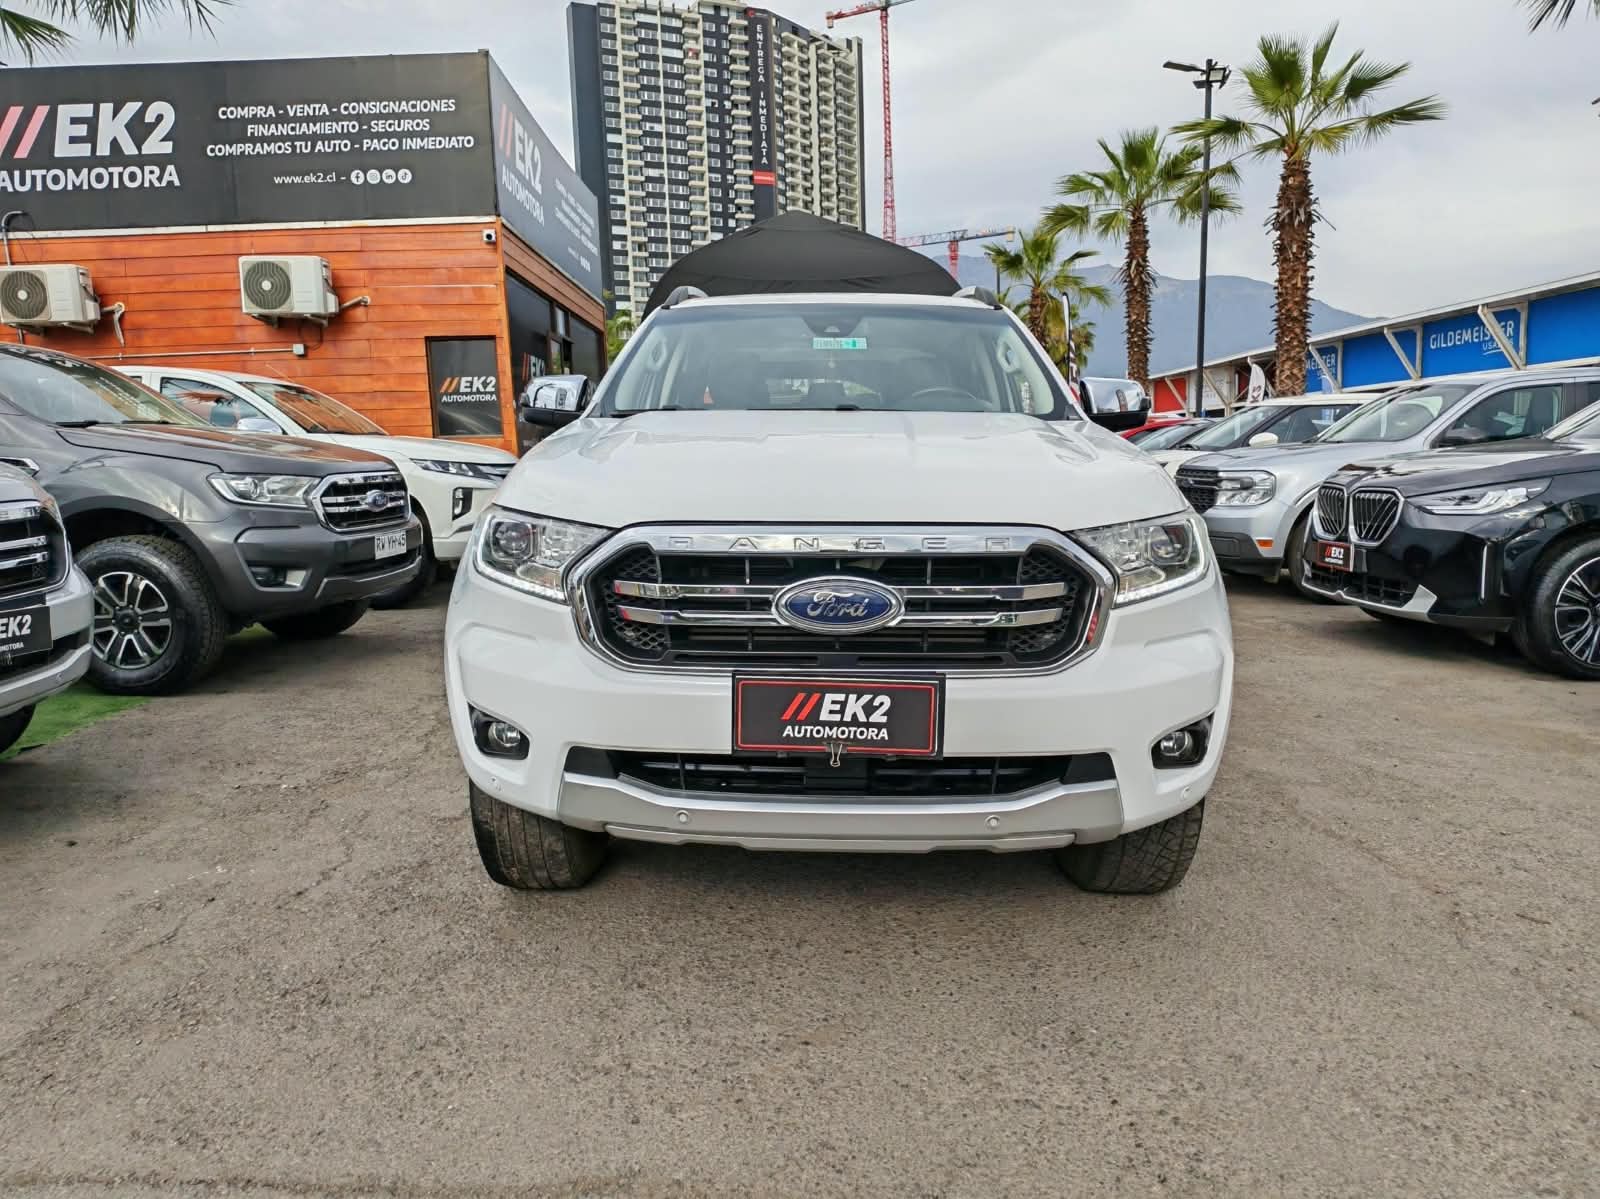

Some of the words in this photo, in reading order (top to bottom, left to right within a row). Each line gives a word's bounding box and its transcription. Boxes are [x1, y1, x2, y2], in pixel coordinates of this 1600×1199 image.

[756, 24, 766, 83] ENTREGA
[218, 105, 276, 119] COMPRA
[286, 103, 330, 117] VENTA
[340, 99, 456, 115] CONSIGNACIONES
[54, 101, 176, 158] EK2
[247, 121, 360, 137] FINANCIAMIENTO
[370, 118, 430, 132] SEGUROS
[759, 90, 769, 165] INMEDIATA
[206, 142, 292, 156] COMPRAMOS
[294, 141, 312, 153] TU
[315, 139, 351, 153] AUTO
[363, 138, 399, 151] PAGO
[402, 135, 475, 149] INMEDIATO
[0, 164, 181, 193] AUTOMOTORA
[273, 172, 337, 184] www.ek2.cl
[1430, 321, 1514, 349] GILDEMEISR
[441, 394, 497, 403] AUTOMOTORA
[669, 536, 1011, 551] RANGER
[806, 592, 869, 617] Ford
[819, 693, 891, 722] EK2
[782, 725, 889, 740] AUTOMOTORA
